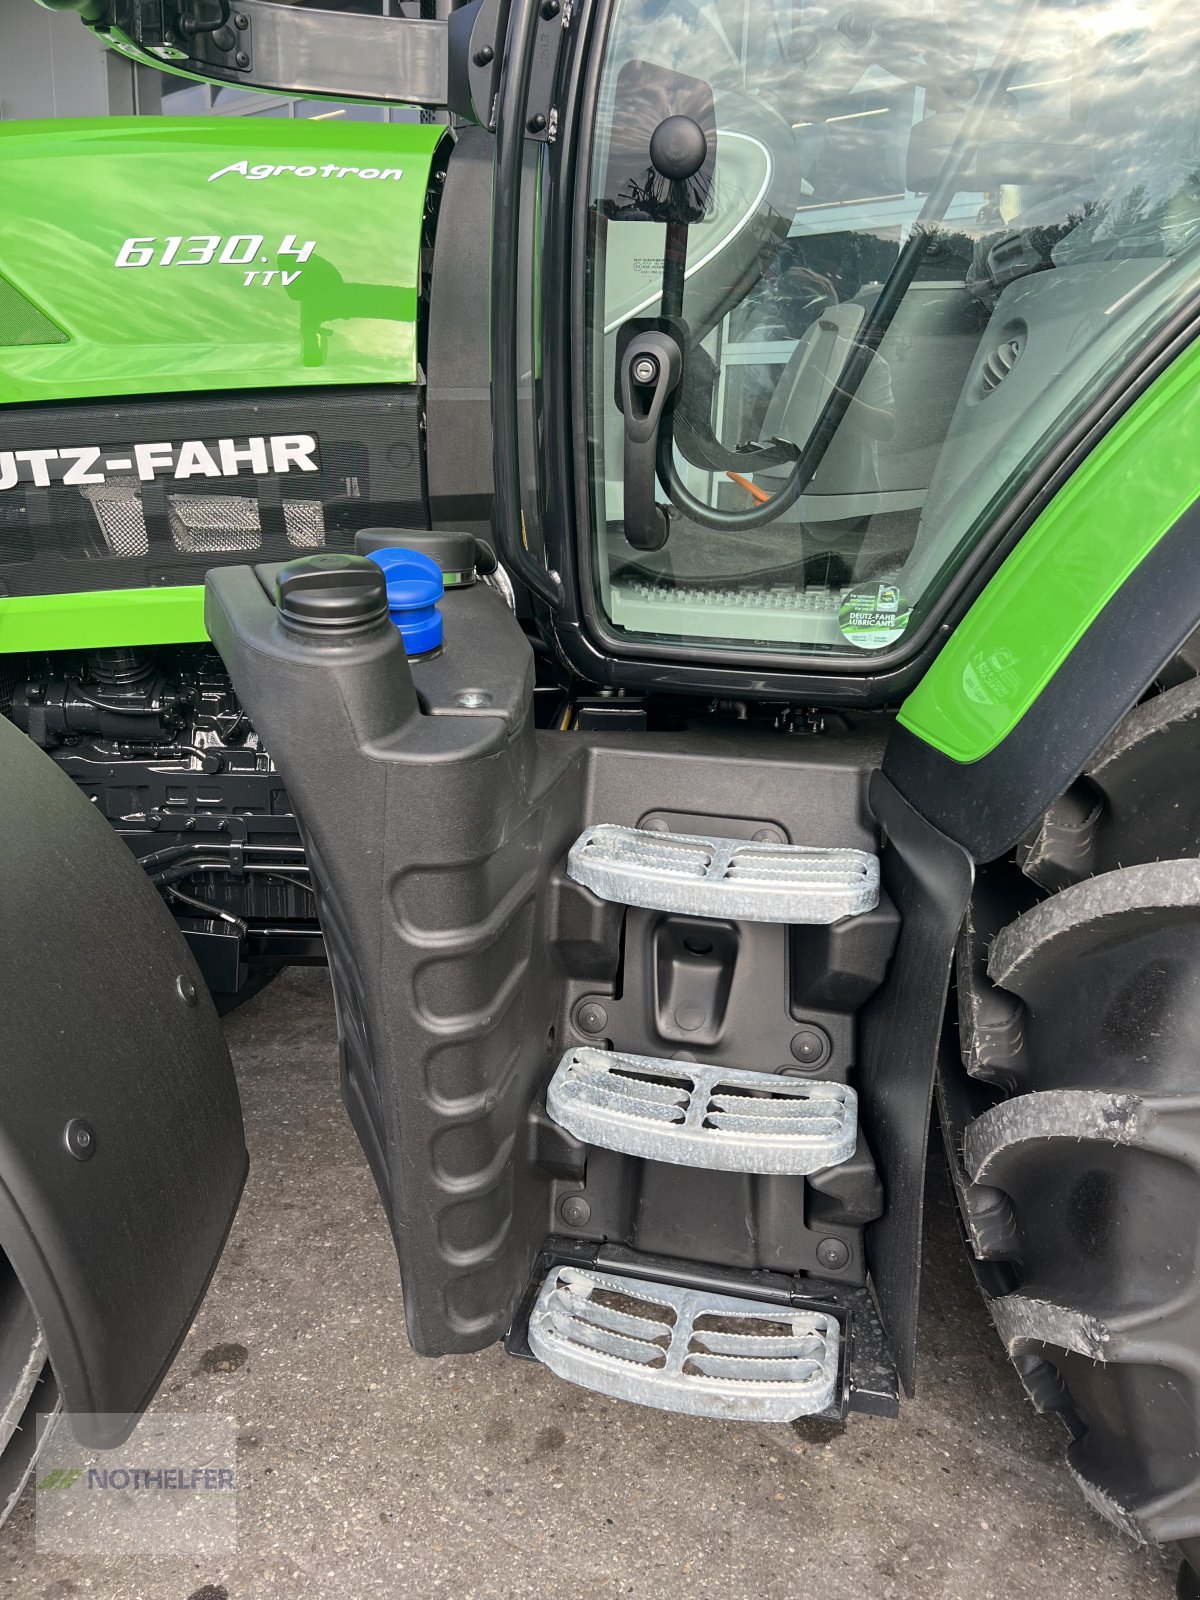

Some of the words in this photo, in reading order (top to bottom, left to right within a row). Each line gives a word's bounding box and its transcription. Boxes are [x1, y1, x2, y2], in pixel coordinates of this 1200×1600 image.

[208, 160, 403, 182] Agrotron
[114, 234, 316, 268] 6130.4
[243, 270, 301, 287] TTV
[848, 618, 895, 627] LUBRICANTS
[849, 612, 896, 621] DEUTZ-FAHR
